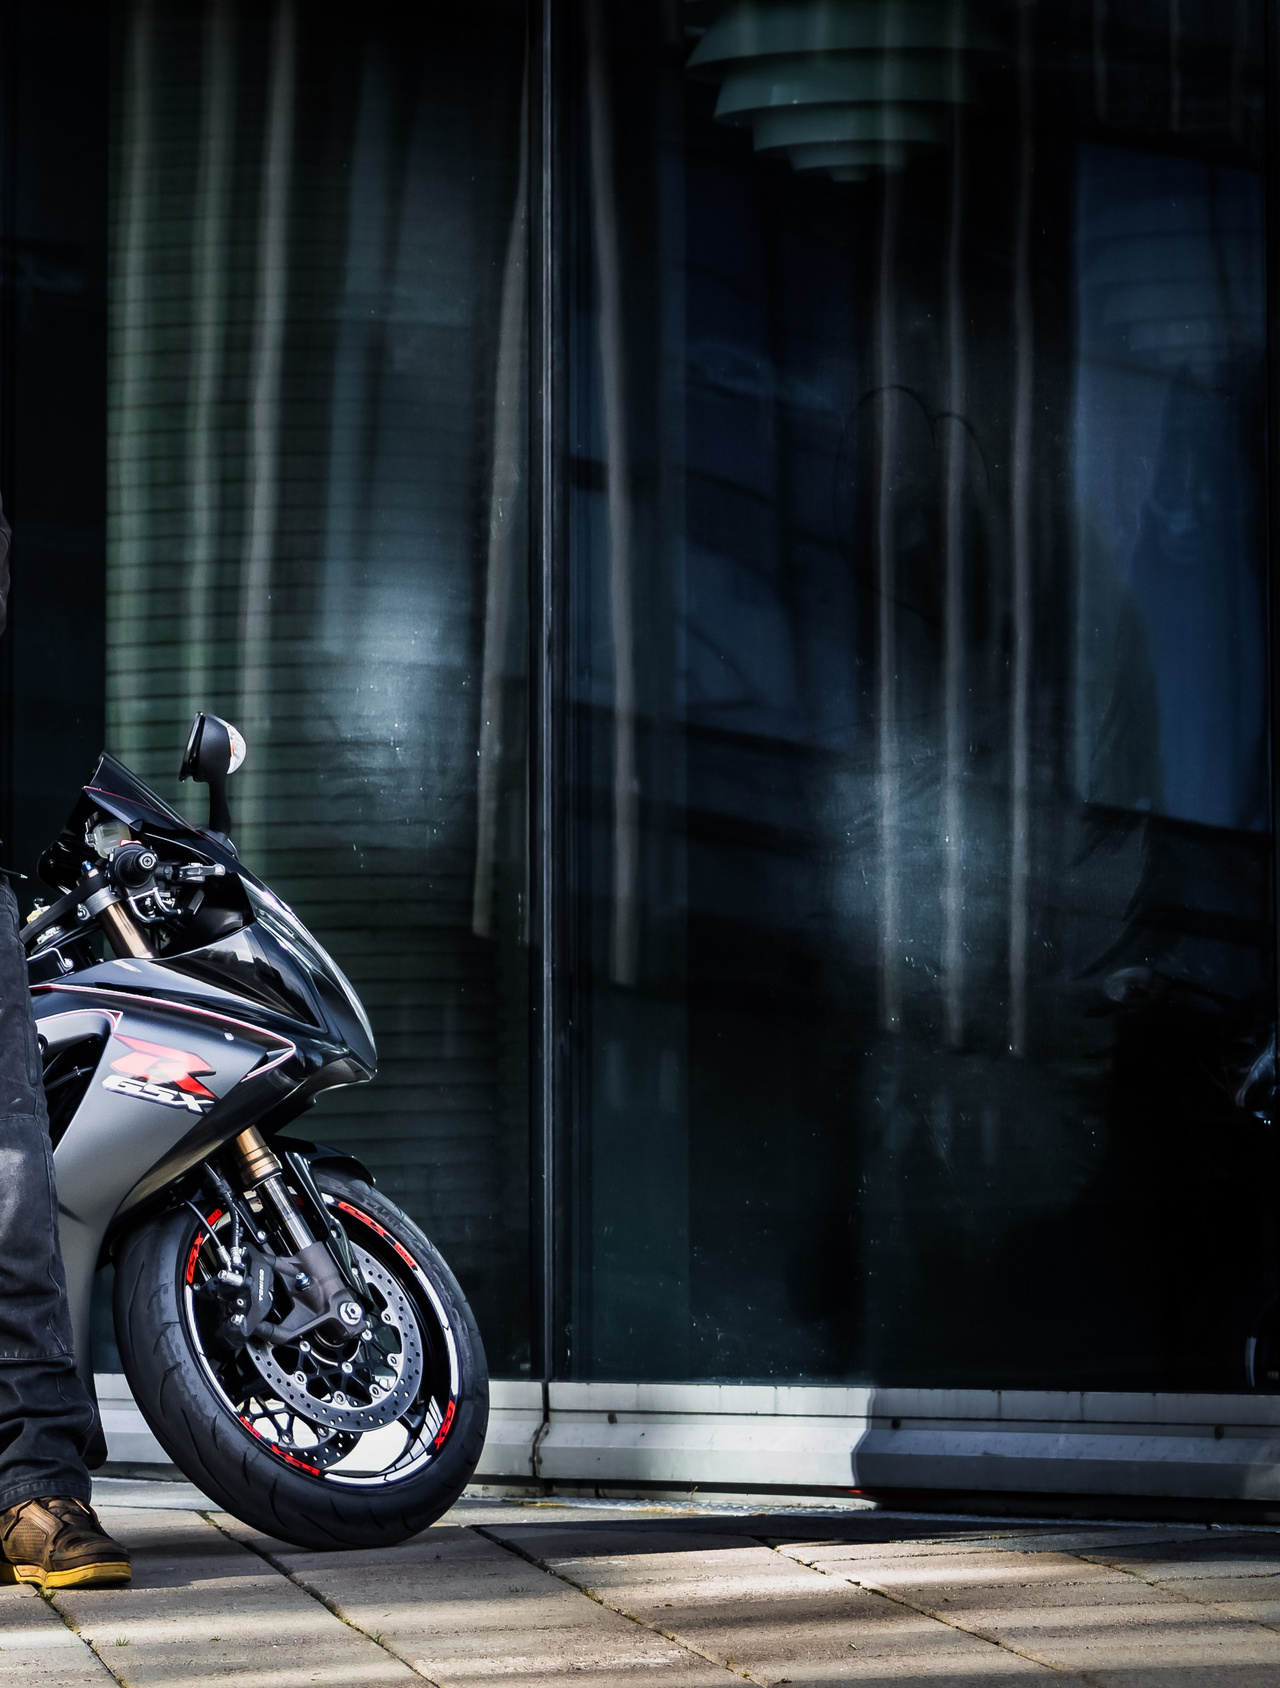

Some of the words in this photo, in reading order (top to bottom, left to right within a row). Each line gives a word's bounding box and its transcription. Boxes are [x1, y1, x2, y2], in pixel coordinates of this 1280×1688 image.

[102, 1074, 216, 1113] GSX
[338, 1200, 385, 1238] GSX
[185, 1230, 204, 1284] GSX
[434, 1399, 456, 1450] GSX
